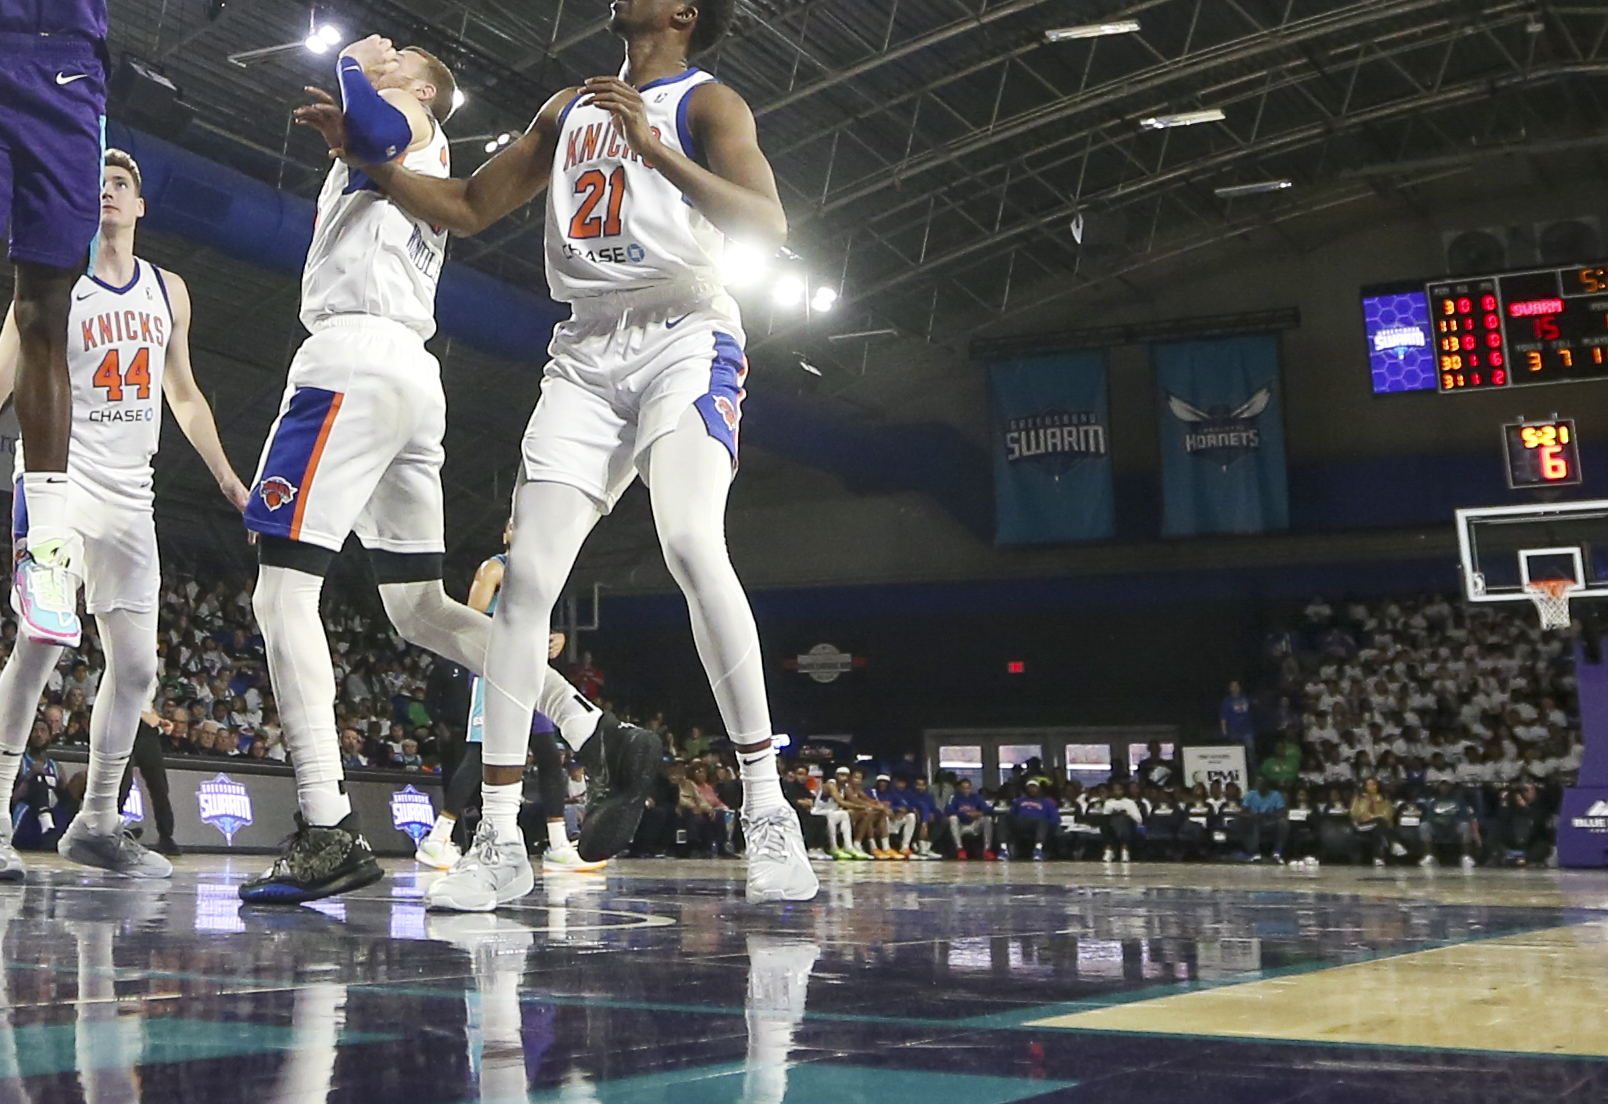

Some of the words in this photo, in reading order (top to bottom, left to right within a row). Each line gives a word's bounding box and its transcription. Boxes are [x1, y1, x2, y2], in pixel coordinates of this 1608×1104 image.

[567, 165, 625, 239] 21
[81, 310, 164, 352] KNICKS
[93, 347, 151, 402] 44
[88, 408, 144, 423] CHASE
[1005, 424, 1106, 461] SWARM
[1185, 429, 1260, 453] HORNETS
[1521, 425, 1570, 448] 5:21
[1541, 445, 1568, 480] 6
[199, 793, 252, 821] SWARM
[392, 802, 436, 827] SWARM
